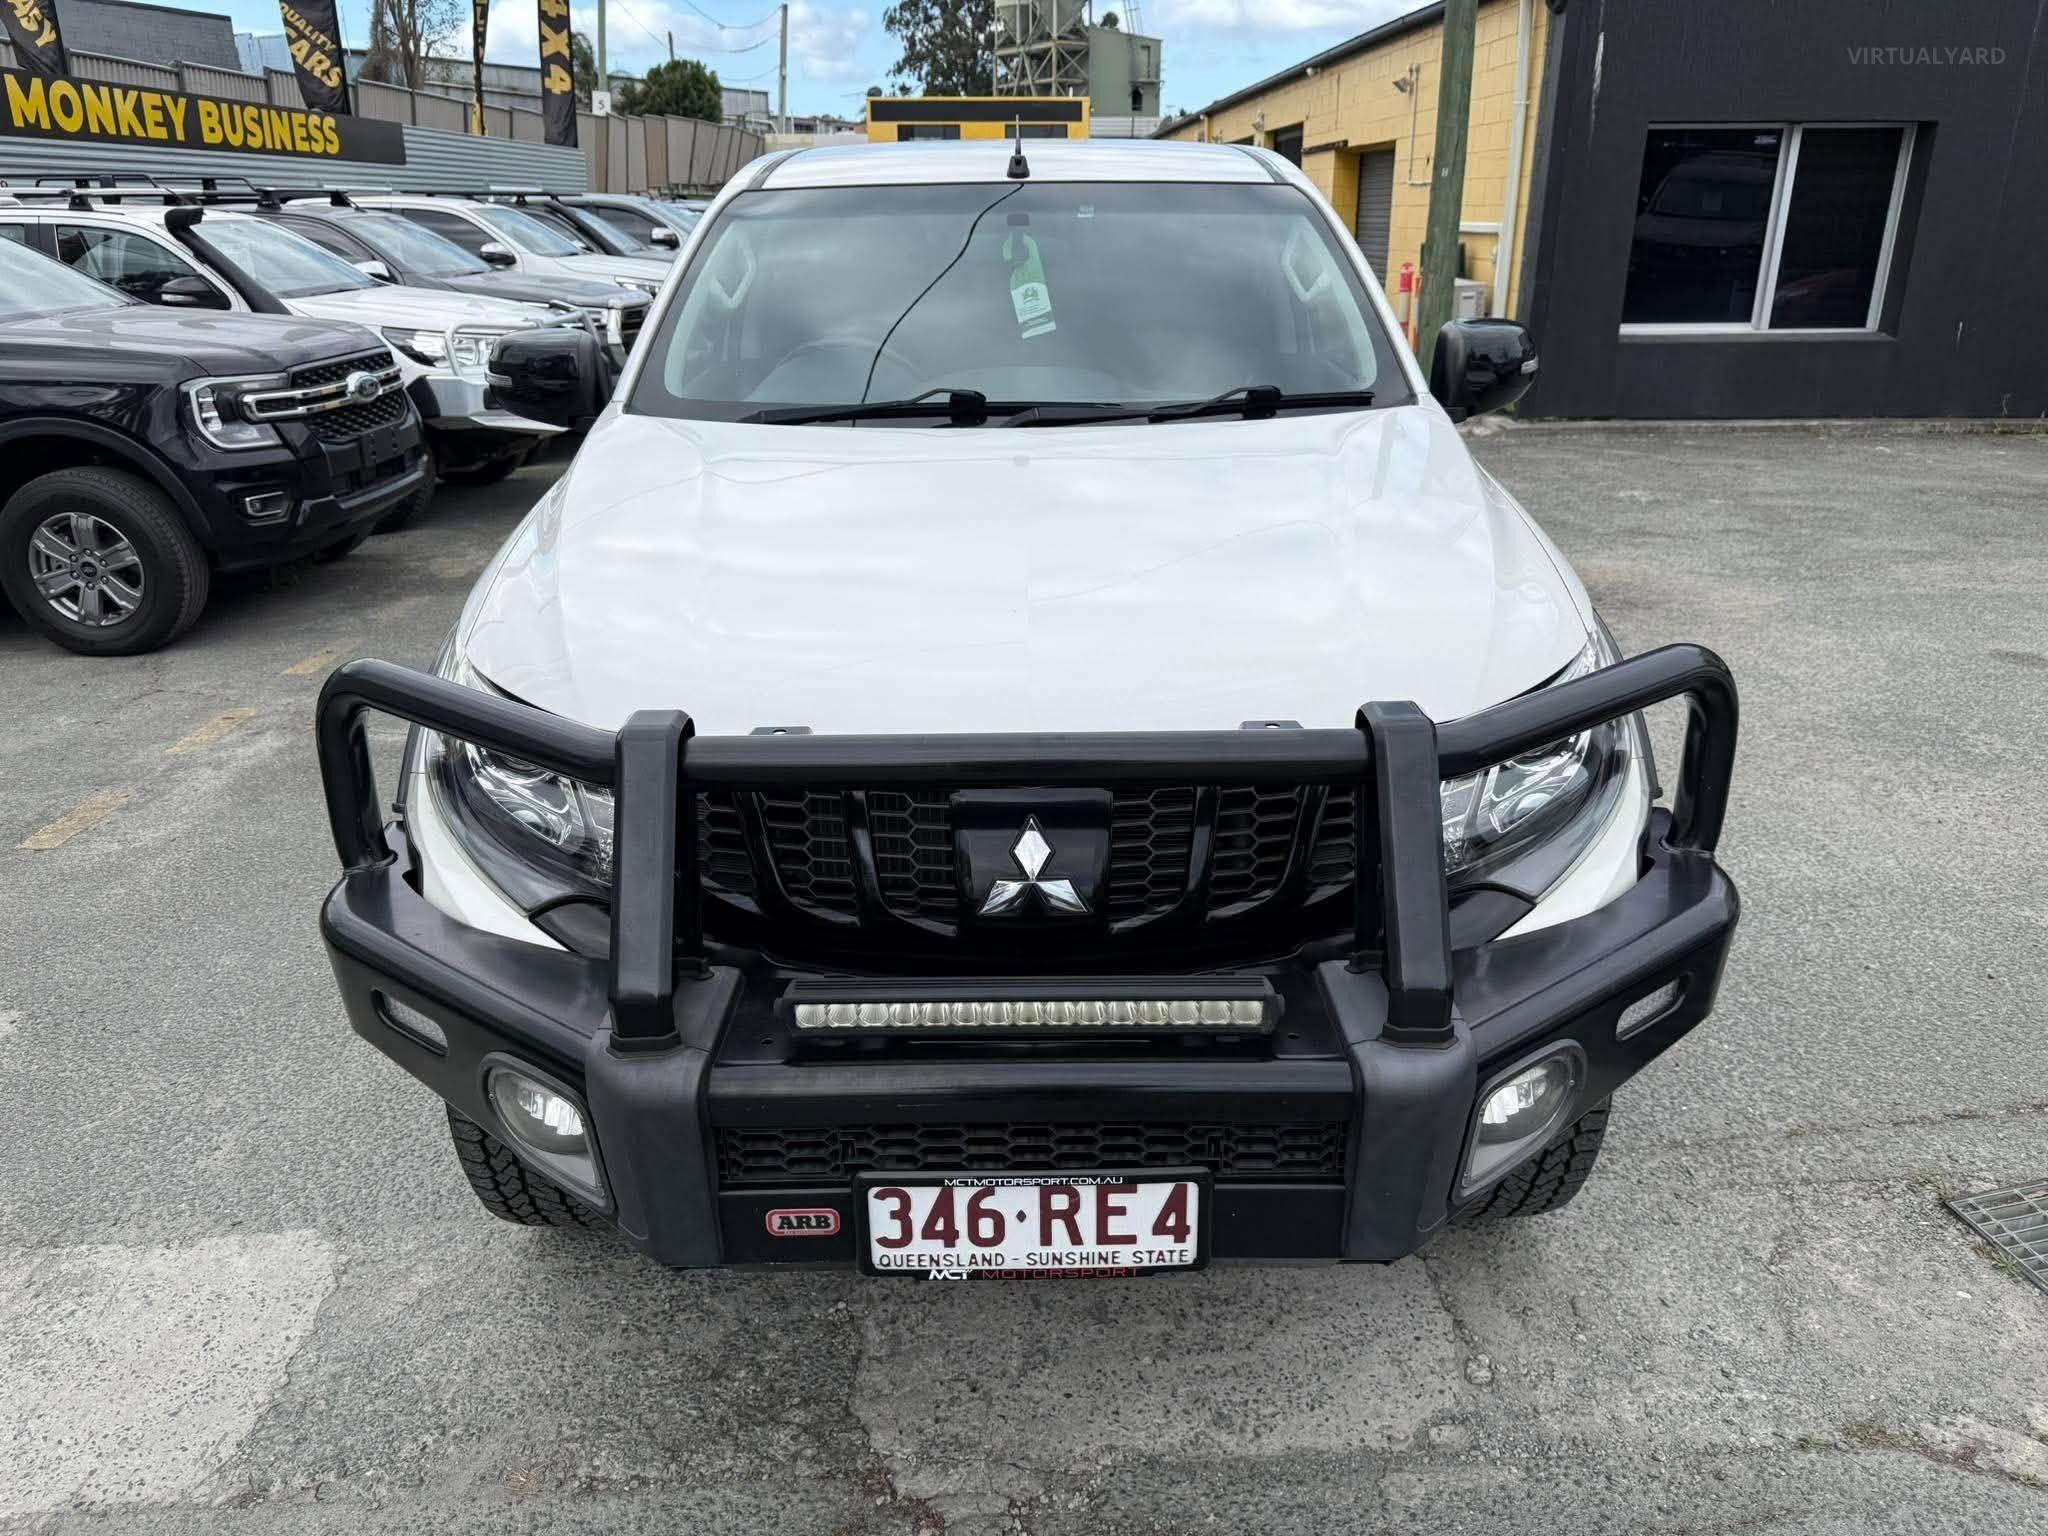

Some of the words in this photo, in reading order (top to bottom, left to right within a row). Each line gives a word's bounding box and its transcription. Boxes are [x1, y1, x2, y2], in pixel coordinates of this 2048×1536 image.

[4, 73, 187, 142] MONKEY
[198, 99, 340, 155] BUSINESS
[944, 1177, 1123, 1186] MCTMOTORSPORT.COM.AU
[778, 1215, 832, 1230] ARB
[879, 1253, 1005, 1267] QUEENSLAND
[1026, 1251, 1121, 1266] SUNSHINE
[1132, 1250, 1189, 1264] STATE
[928, 1269, 972, 1281] MCT
[982, 1267, 1138, 1280] MOTORSPORT
